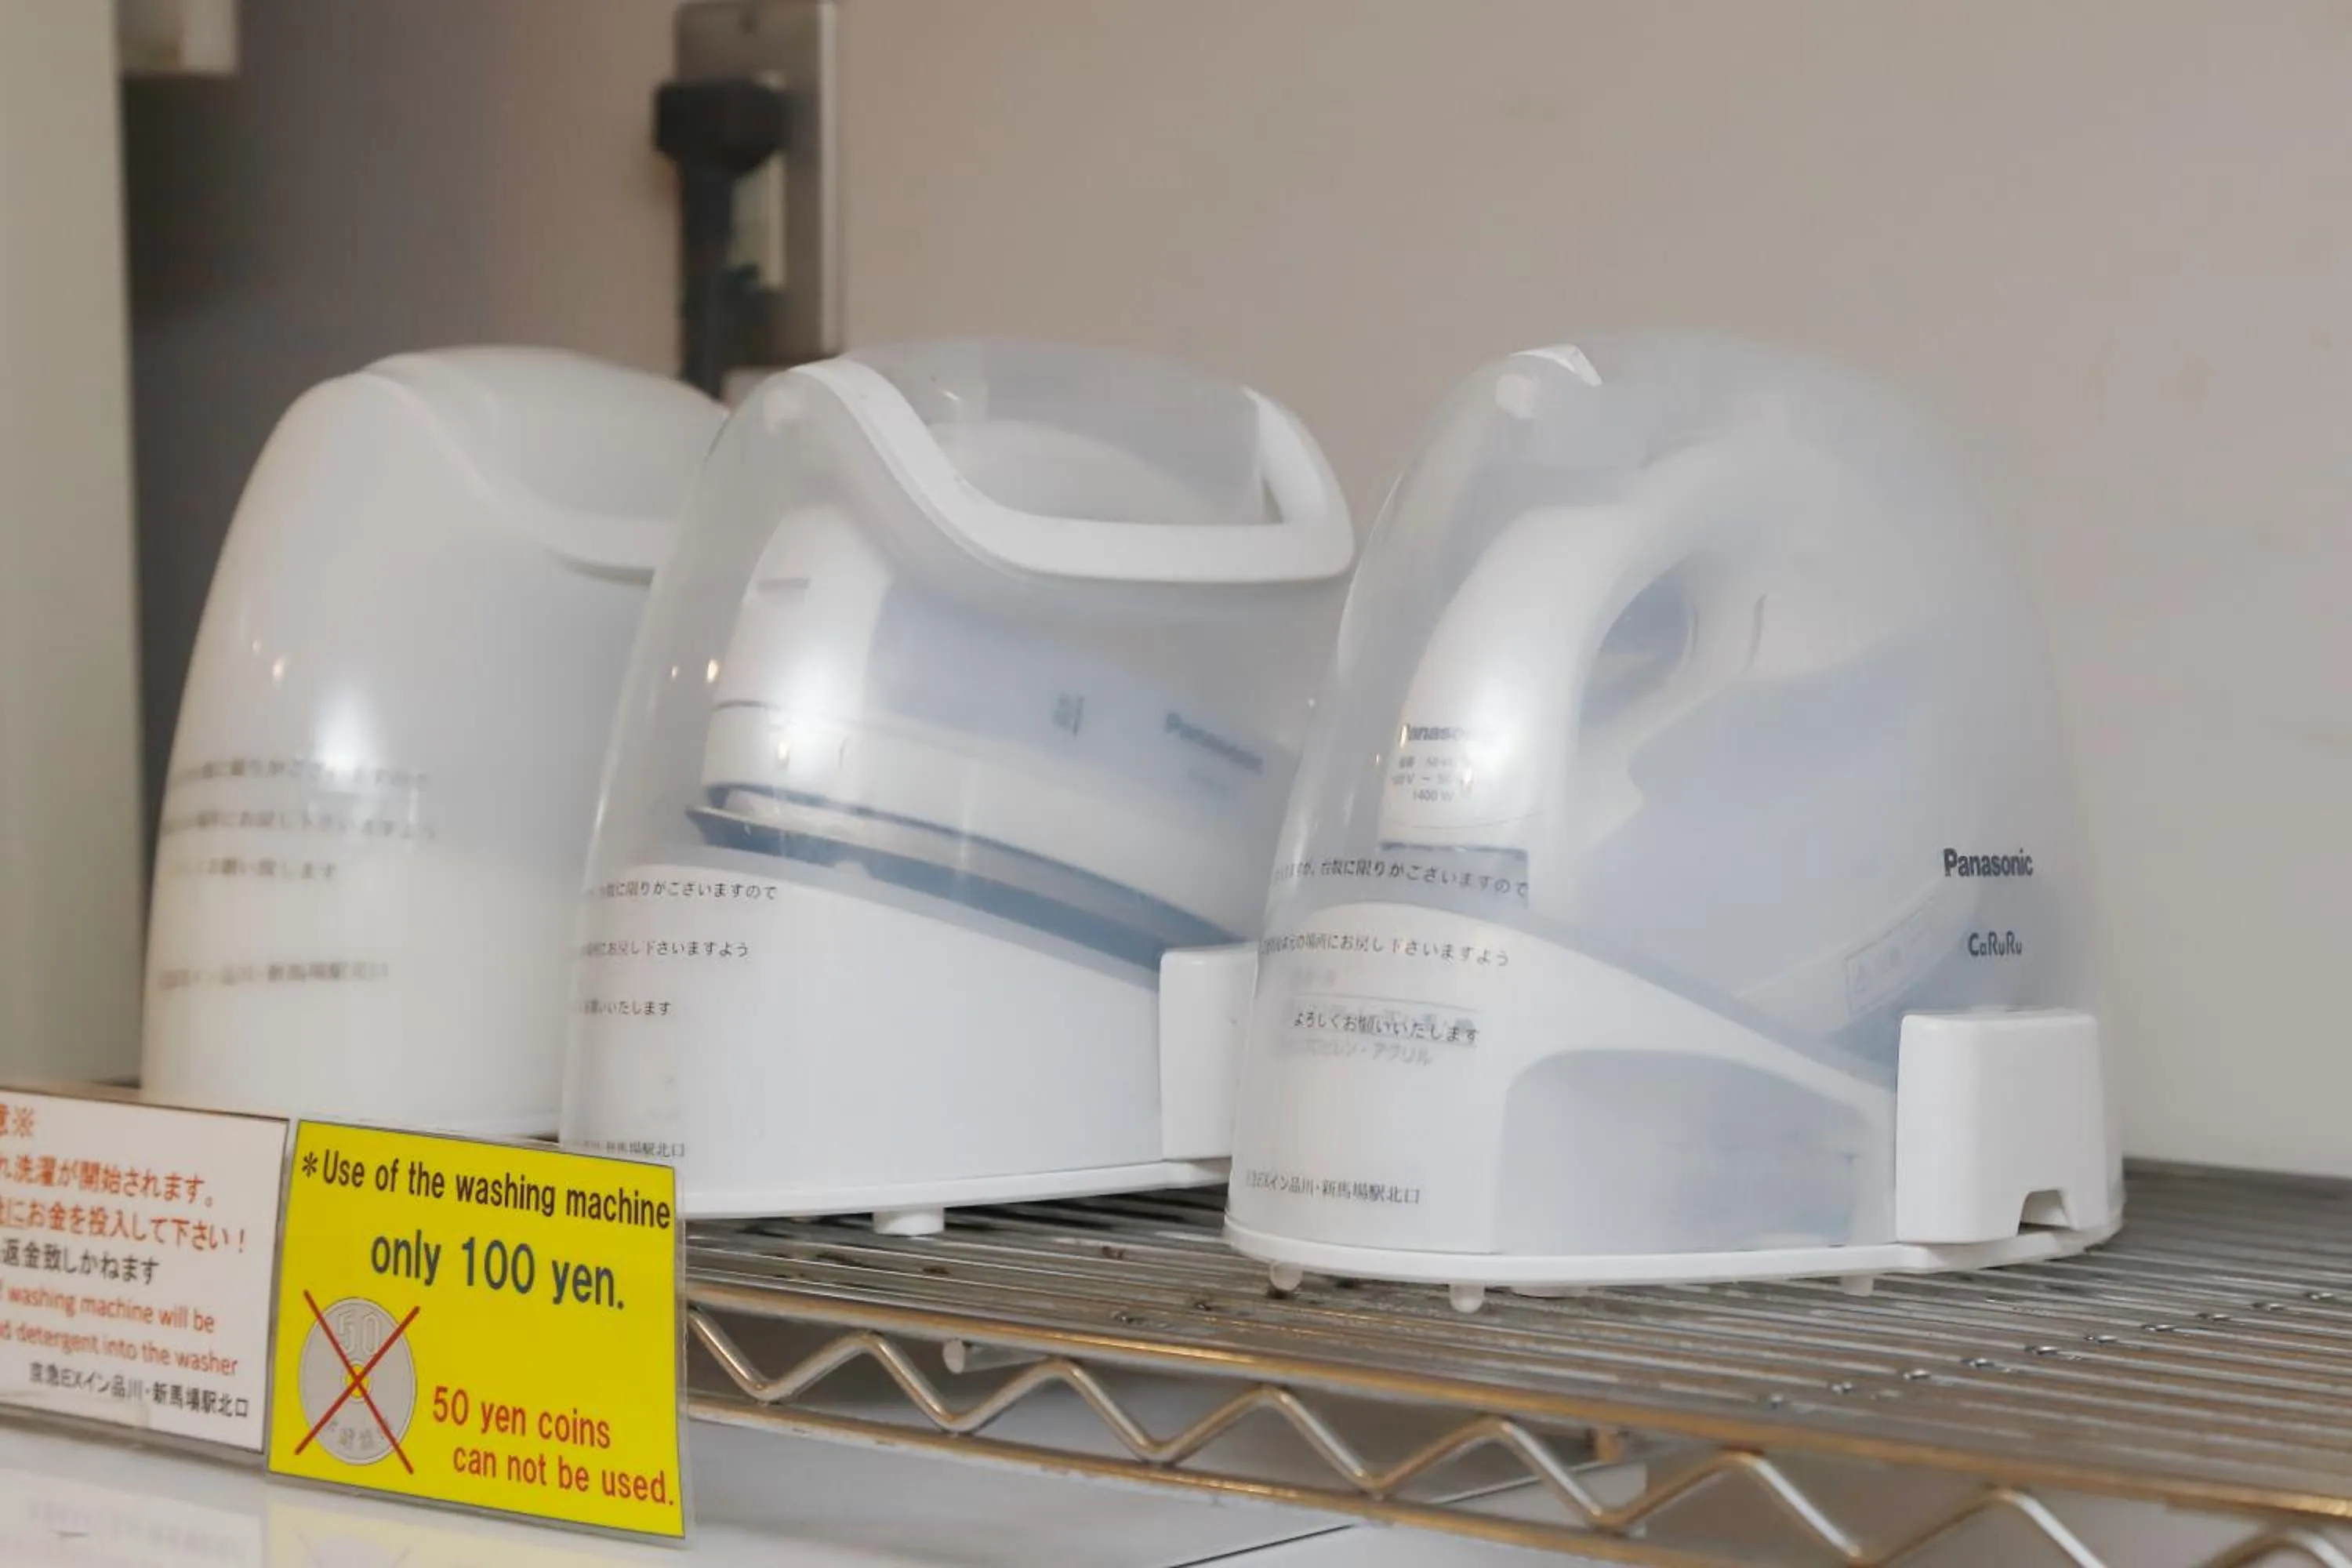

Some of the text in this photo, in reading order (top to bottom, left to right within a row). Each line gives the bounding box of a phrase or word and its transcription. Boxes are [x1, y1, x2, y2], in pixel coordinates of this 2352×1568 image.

[1943, 848, 2034, 877] Panasonic
[1968, 931, 2023, 957] CaRuRu
[376, 1158, 399, 1192] of
[408, 1162, 445, 1199] the
[456, 1173, 555, 1217] washing
[566, 1189, 670, 1229] machine
[372, 1229, 625, 1310] only 100 yen.
[80, 1298, 154, 1324] machine
[158, 1304, 188, 1330] will
[194, 1308, 214, 1333] be
[103, 1334, 137, 1361] into
[142, 1341, 171, 1366] the
[175, 1348, 238, 1376] washer
[433, 1386, 611, 1449] 50 yen coins
[453, 1446, 674, 1506] can not be used.
